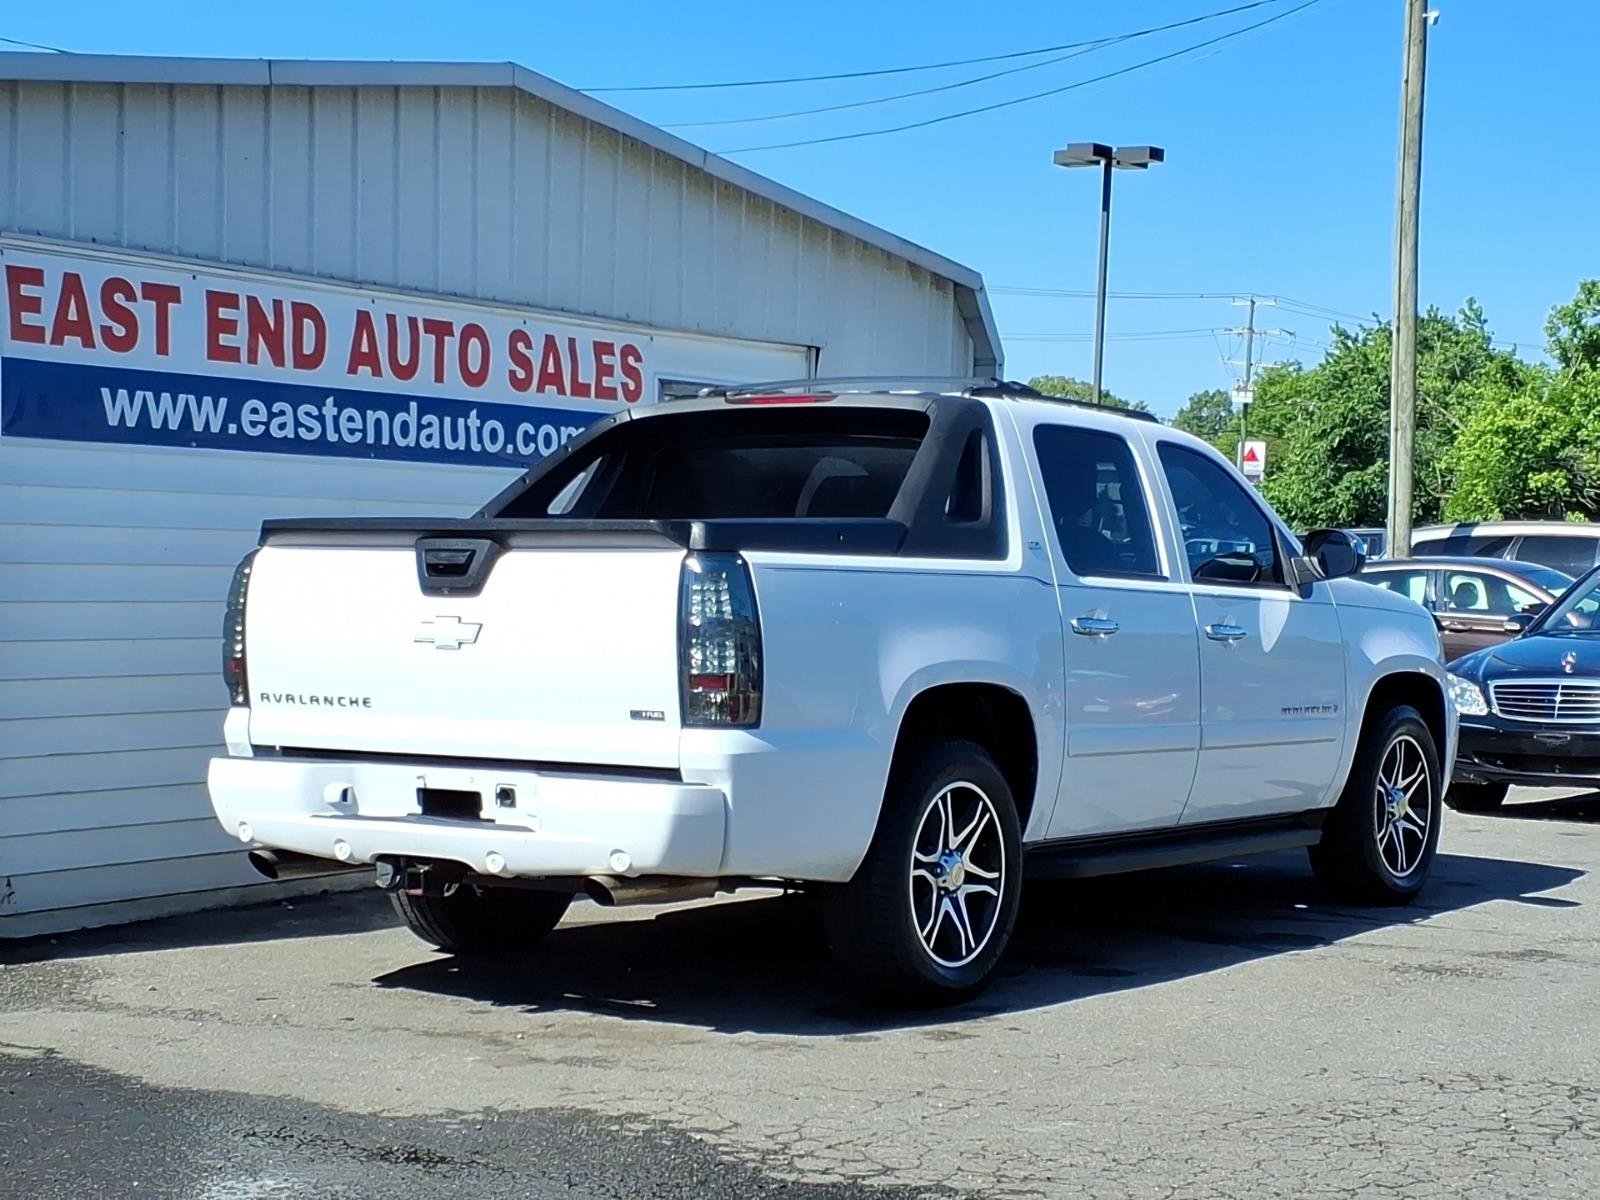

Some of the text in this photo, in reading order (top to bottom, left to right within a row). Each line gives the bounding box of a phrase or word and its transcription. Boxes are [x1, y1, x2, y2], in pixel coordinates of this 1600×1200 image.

[5, 264, 643, 403] EAST END AUTO SALES
[260, 692, 372, 708] AVALANCHE
